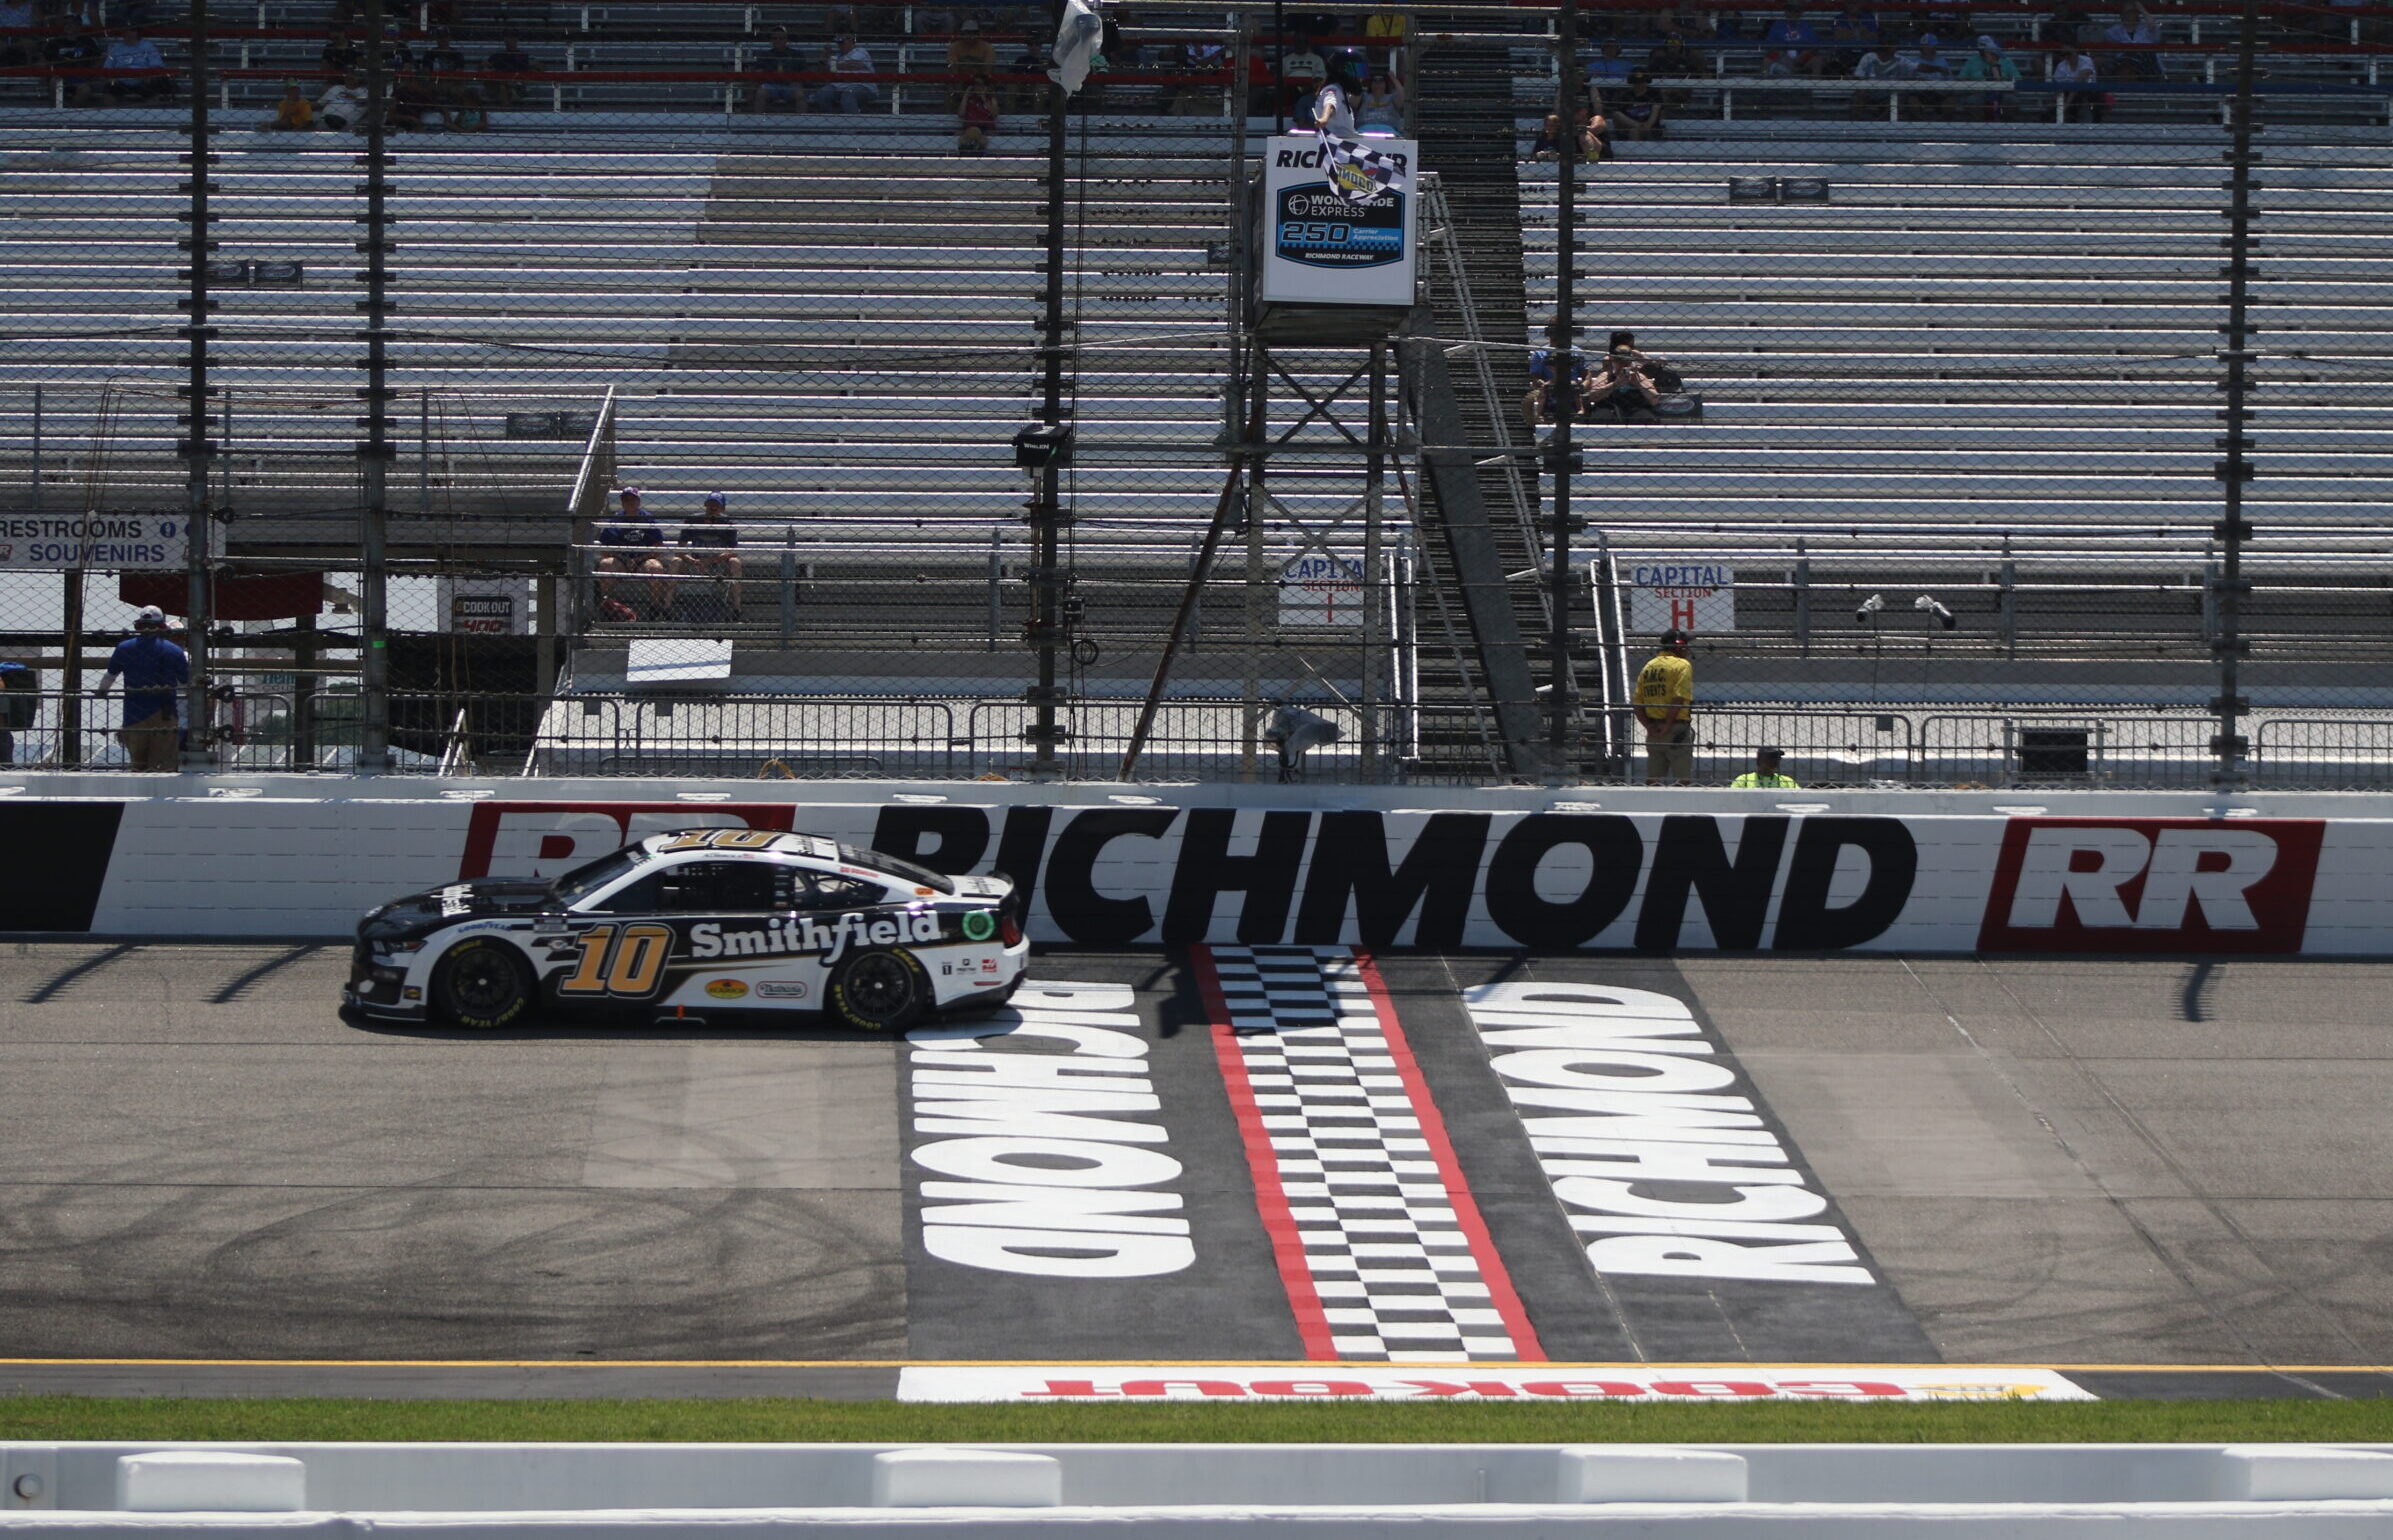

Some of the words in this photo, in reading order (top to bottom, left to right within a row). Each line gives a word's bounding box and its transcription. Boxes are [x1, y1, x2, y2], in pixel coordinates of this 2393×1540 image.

[1311, 206, 1365, 218] EXPRESS
[1282, 222, 1351, 243] 250
[1353, 234, 1399, 242] Appreciation
[1305, 252, 1340, 260] RICHMOND
[1341, 253, 1374, 261] RACEWAY
[0, 520, 142, 538] RESTROOMS
[30, 543, 165, 563] SOUVENIRS
[1636, 566, 1729, 585] CAPITAL
[1303, 580, 1360, 592] SECTION
[1655, 587, 1712, 599] SECTION
[1671, 600, 1694, 630] H
[871, 805, 1917, 951] RICHMOND
[2007, 827, 2279, 930] RR
[690, 910, 942, 965] Smithfield
[558, 922, 676, 1000] 10
[905, 978, 1197, 1278] RICHMOND
[1462, 981, 1876, 1284] RICHMOND
